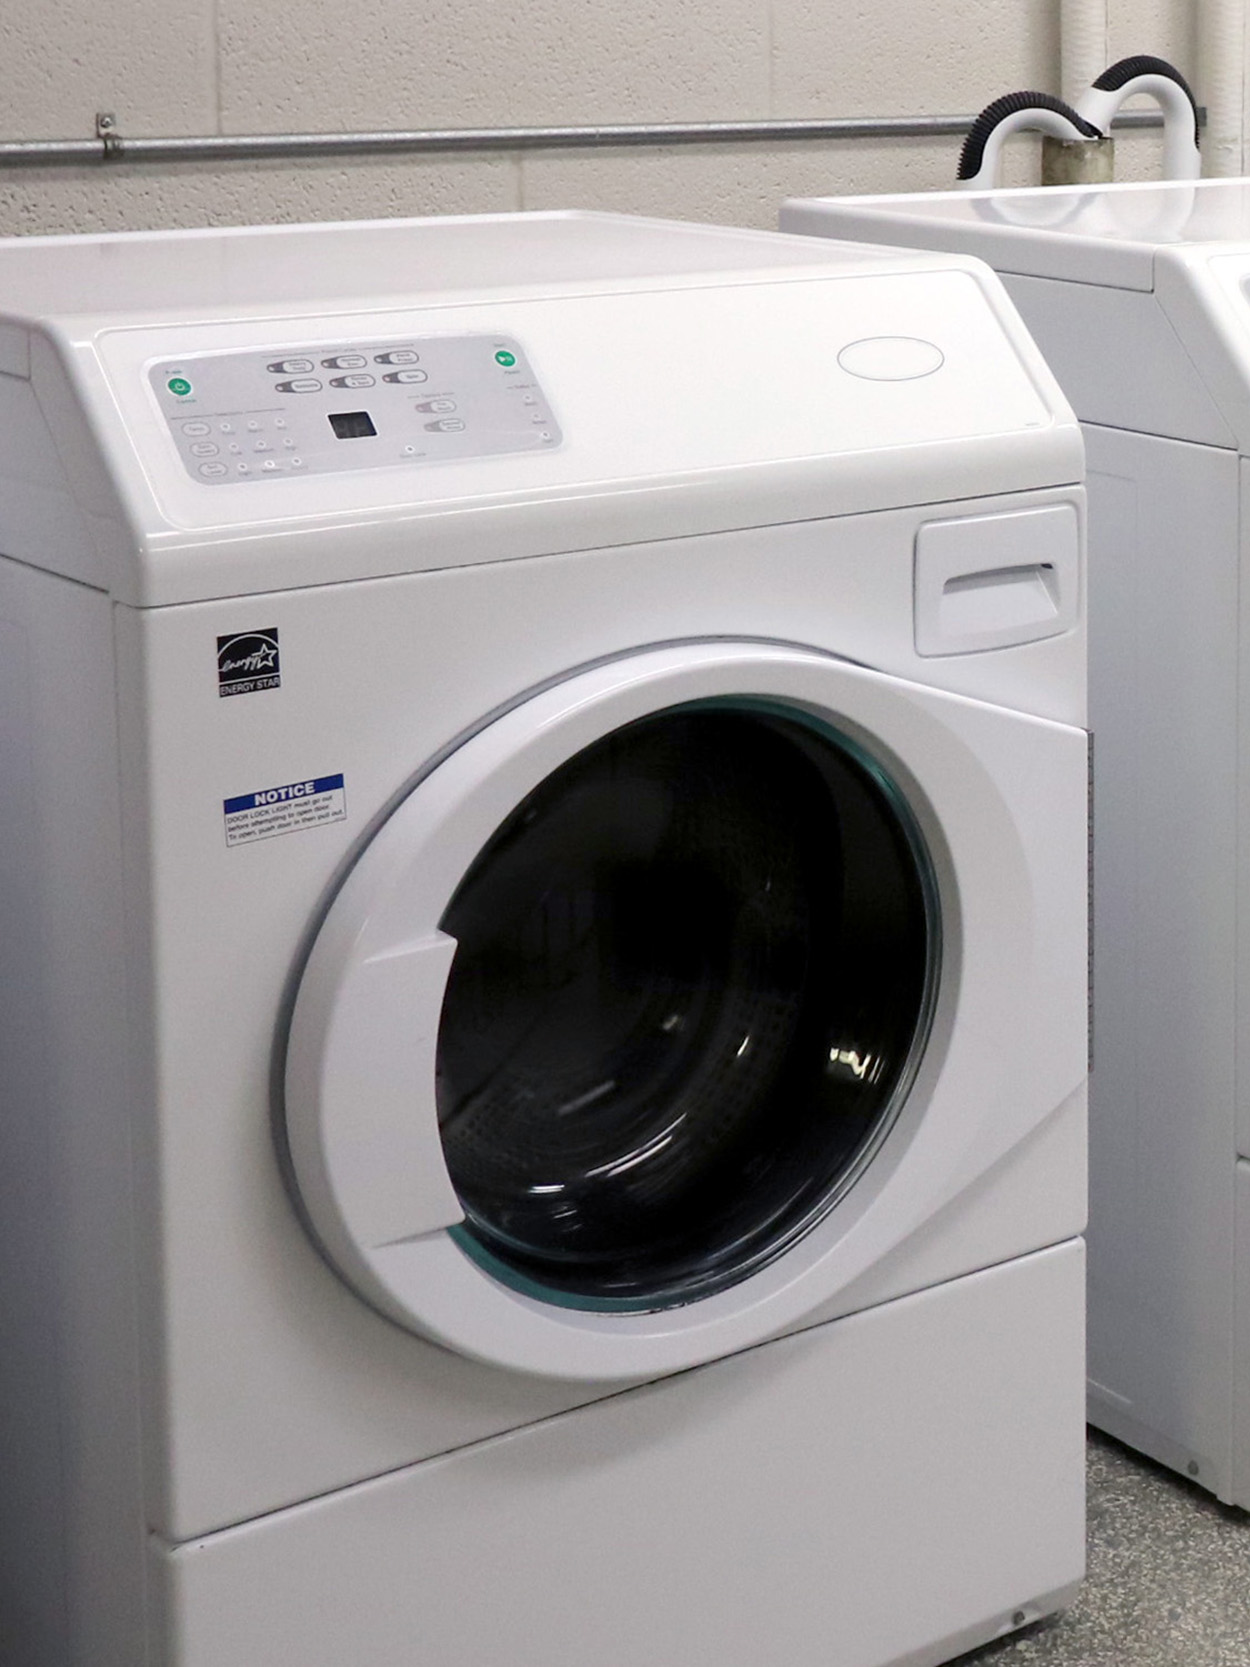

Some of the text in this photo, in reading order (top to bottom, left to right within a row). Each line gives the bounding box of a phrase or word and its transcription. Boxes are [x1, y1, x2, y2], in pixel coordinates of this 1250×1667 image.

[220, 676, 281, 696] ENERGY STAR
[254, 781, 315, 806] NOTICE
[228, 814, 249, 824] DOOR
[250, 810, 271, 819] LOCK
[271, 803, 292, 814] LIGHT
[294, 800, 311, 808] must
[312, 798, 321, 806] go
[228, 822, 250, 833] before
[251, 814, 287, 827] attempting
[296, 808, 313, 817] open
[258, 825, 276, 835] push
[277, 821, 293, 830] door
[301, 815, 317, 823] then
[317, 811, 331, 821] pull
